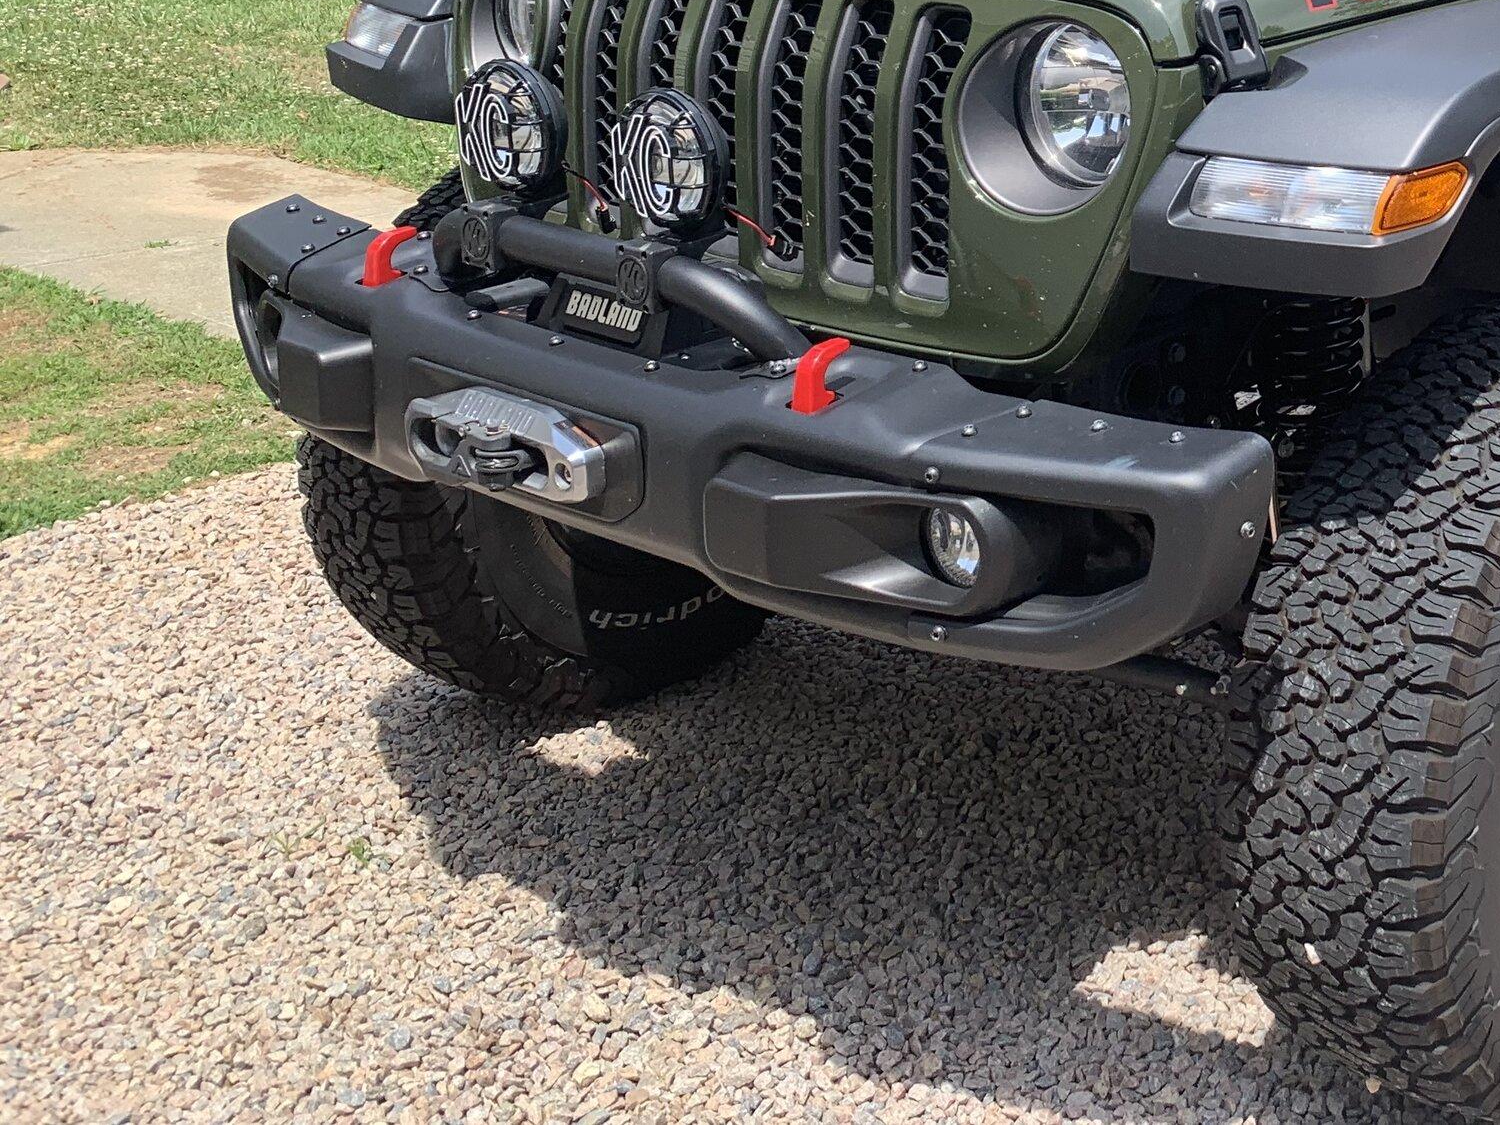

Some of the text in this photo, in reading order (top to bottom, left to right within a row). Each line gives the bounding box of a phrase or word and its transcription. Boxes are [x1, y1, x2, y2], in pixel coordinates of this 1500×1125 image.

[455, 83, 513, 182] KC
[610, 113, 674, 218] KC
[566, 289, 643, 333] BADLAND
[588, 585, 725, 630] odrich
